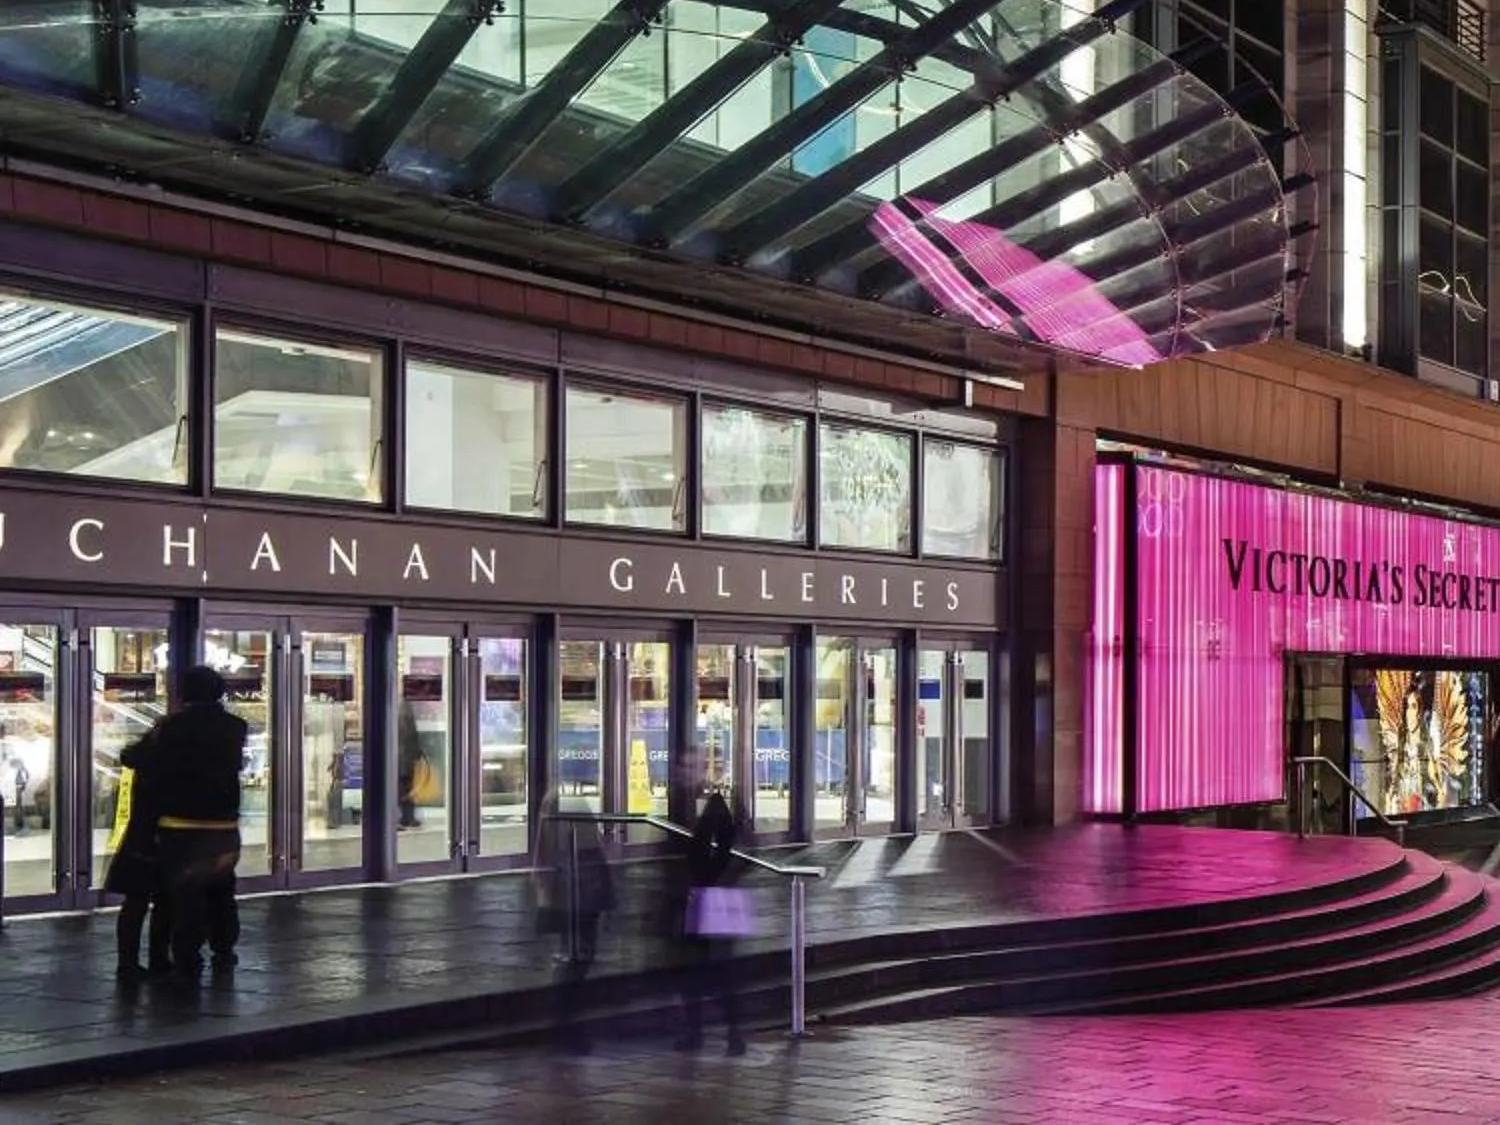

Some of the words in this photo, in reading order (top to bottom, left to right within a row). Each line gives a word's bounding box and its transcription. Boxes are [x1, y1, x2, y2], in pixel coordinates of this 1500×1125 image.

[0, 511, 497, 583] CHANAN
[609, 557, 960, 611] GALLERIES
[1224, 538, 1403, 605] VICTORIA'S
[1414, 563, 1500, 614] SECRET
[649, 750, 668, 761] GRE
[754, 749, 790, 761] GREG
